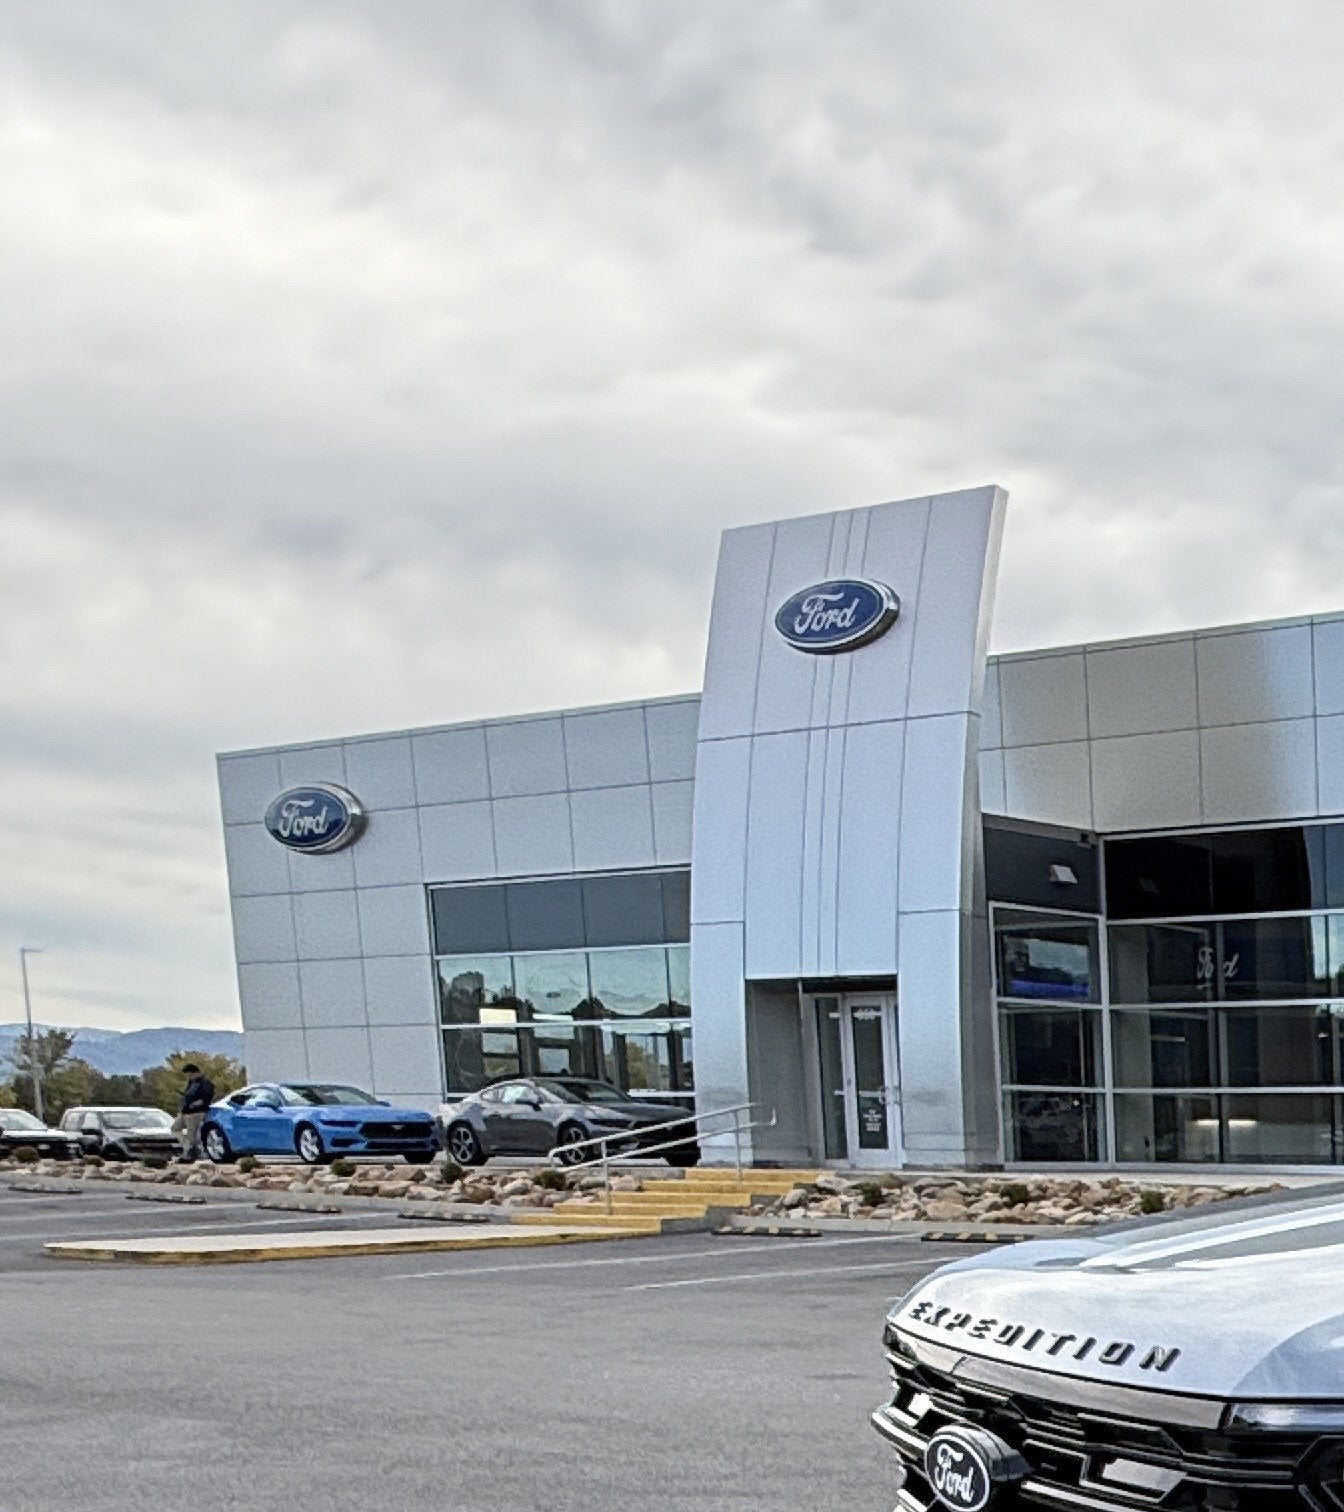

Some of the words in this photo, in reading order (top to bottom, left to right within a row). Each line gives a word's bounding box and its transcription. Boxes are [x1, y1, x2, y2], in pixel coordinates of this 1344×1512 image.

[795, 592, 860, 634] Ford
[279, 800, 328, 837] Ford
[910, 1302, 1181, 1372] EXPEDITION
[935, 1443, 976, 1503] Ford
